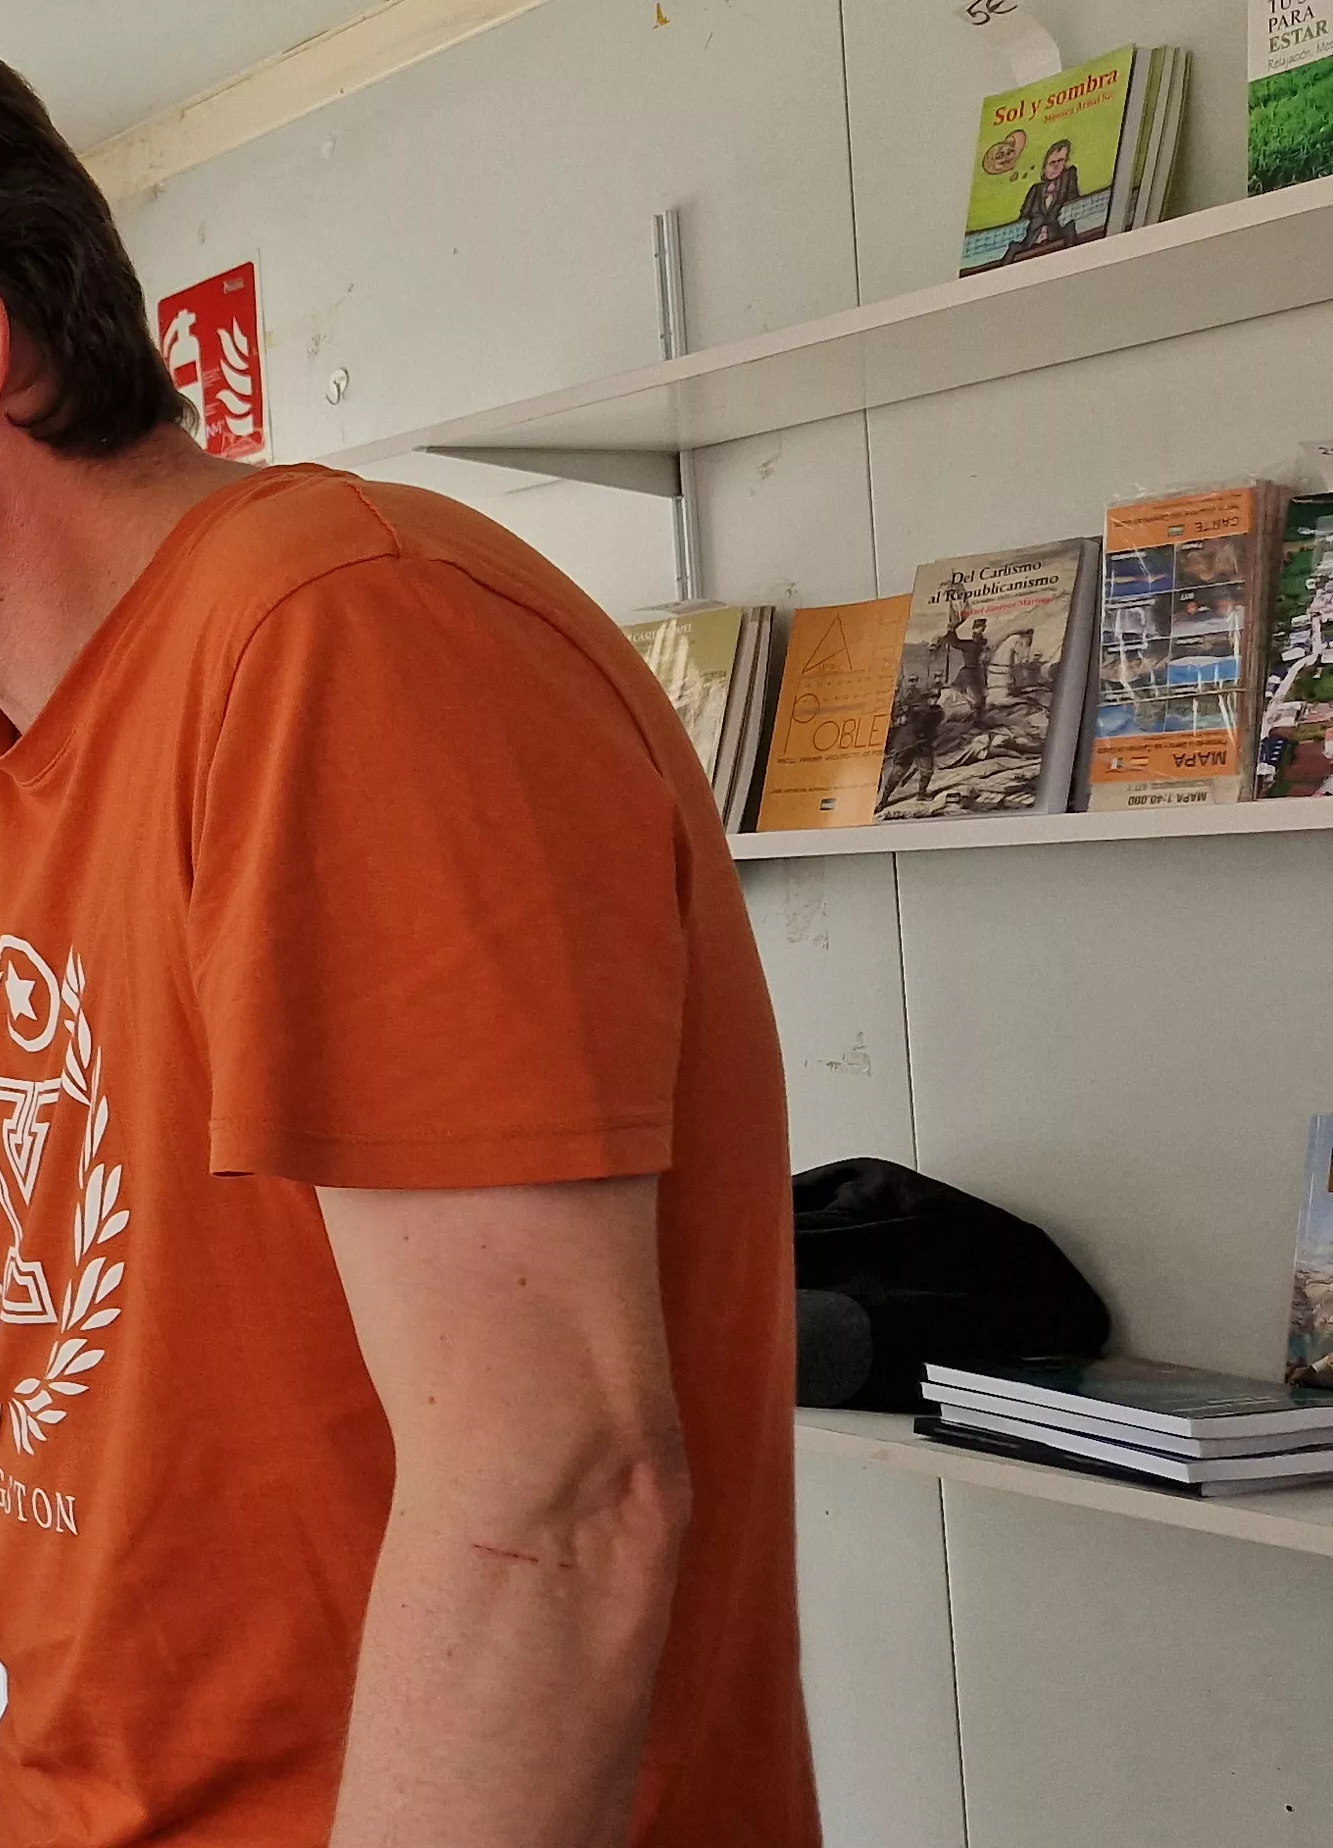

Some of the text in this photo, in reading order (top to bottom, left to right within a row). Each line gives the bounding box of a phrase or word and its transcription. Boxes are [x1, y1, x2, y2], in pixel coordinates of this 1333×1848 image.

[1268, 5, 1315, 33] PARA
[1268, 20, 1329, 54] ESTAR
[993, 69, 1119, 126] Sol y sombra
[1194, 517, 1239, 532] CARTE
[951, 561, 1042, 585] Del Carlismo
[927, 594, 941, 605] al
[945, 575, 1059, 604] Republicanismo
[1173, 751, 1226, 767] MAPA
[1128, 792, 1208, 805] MAPA 1:40.000
